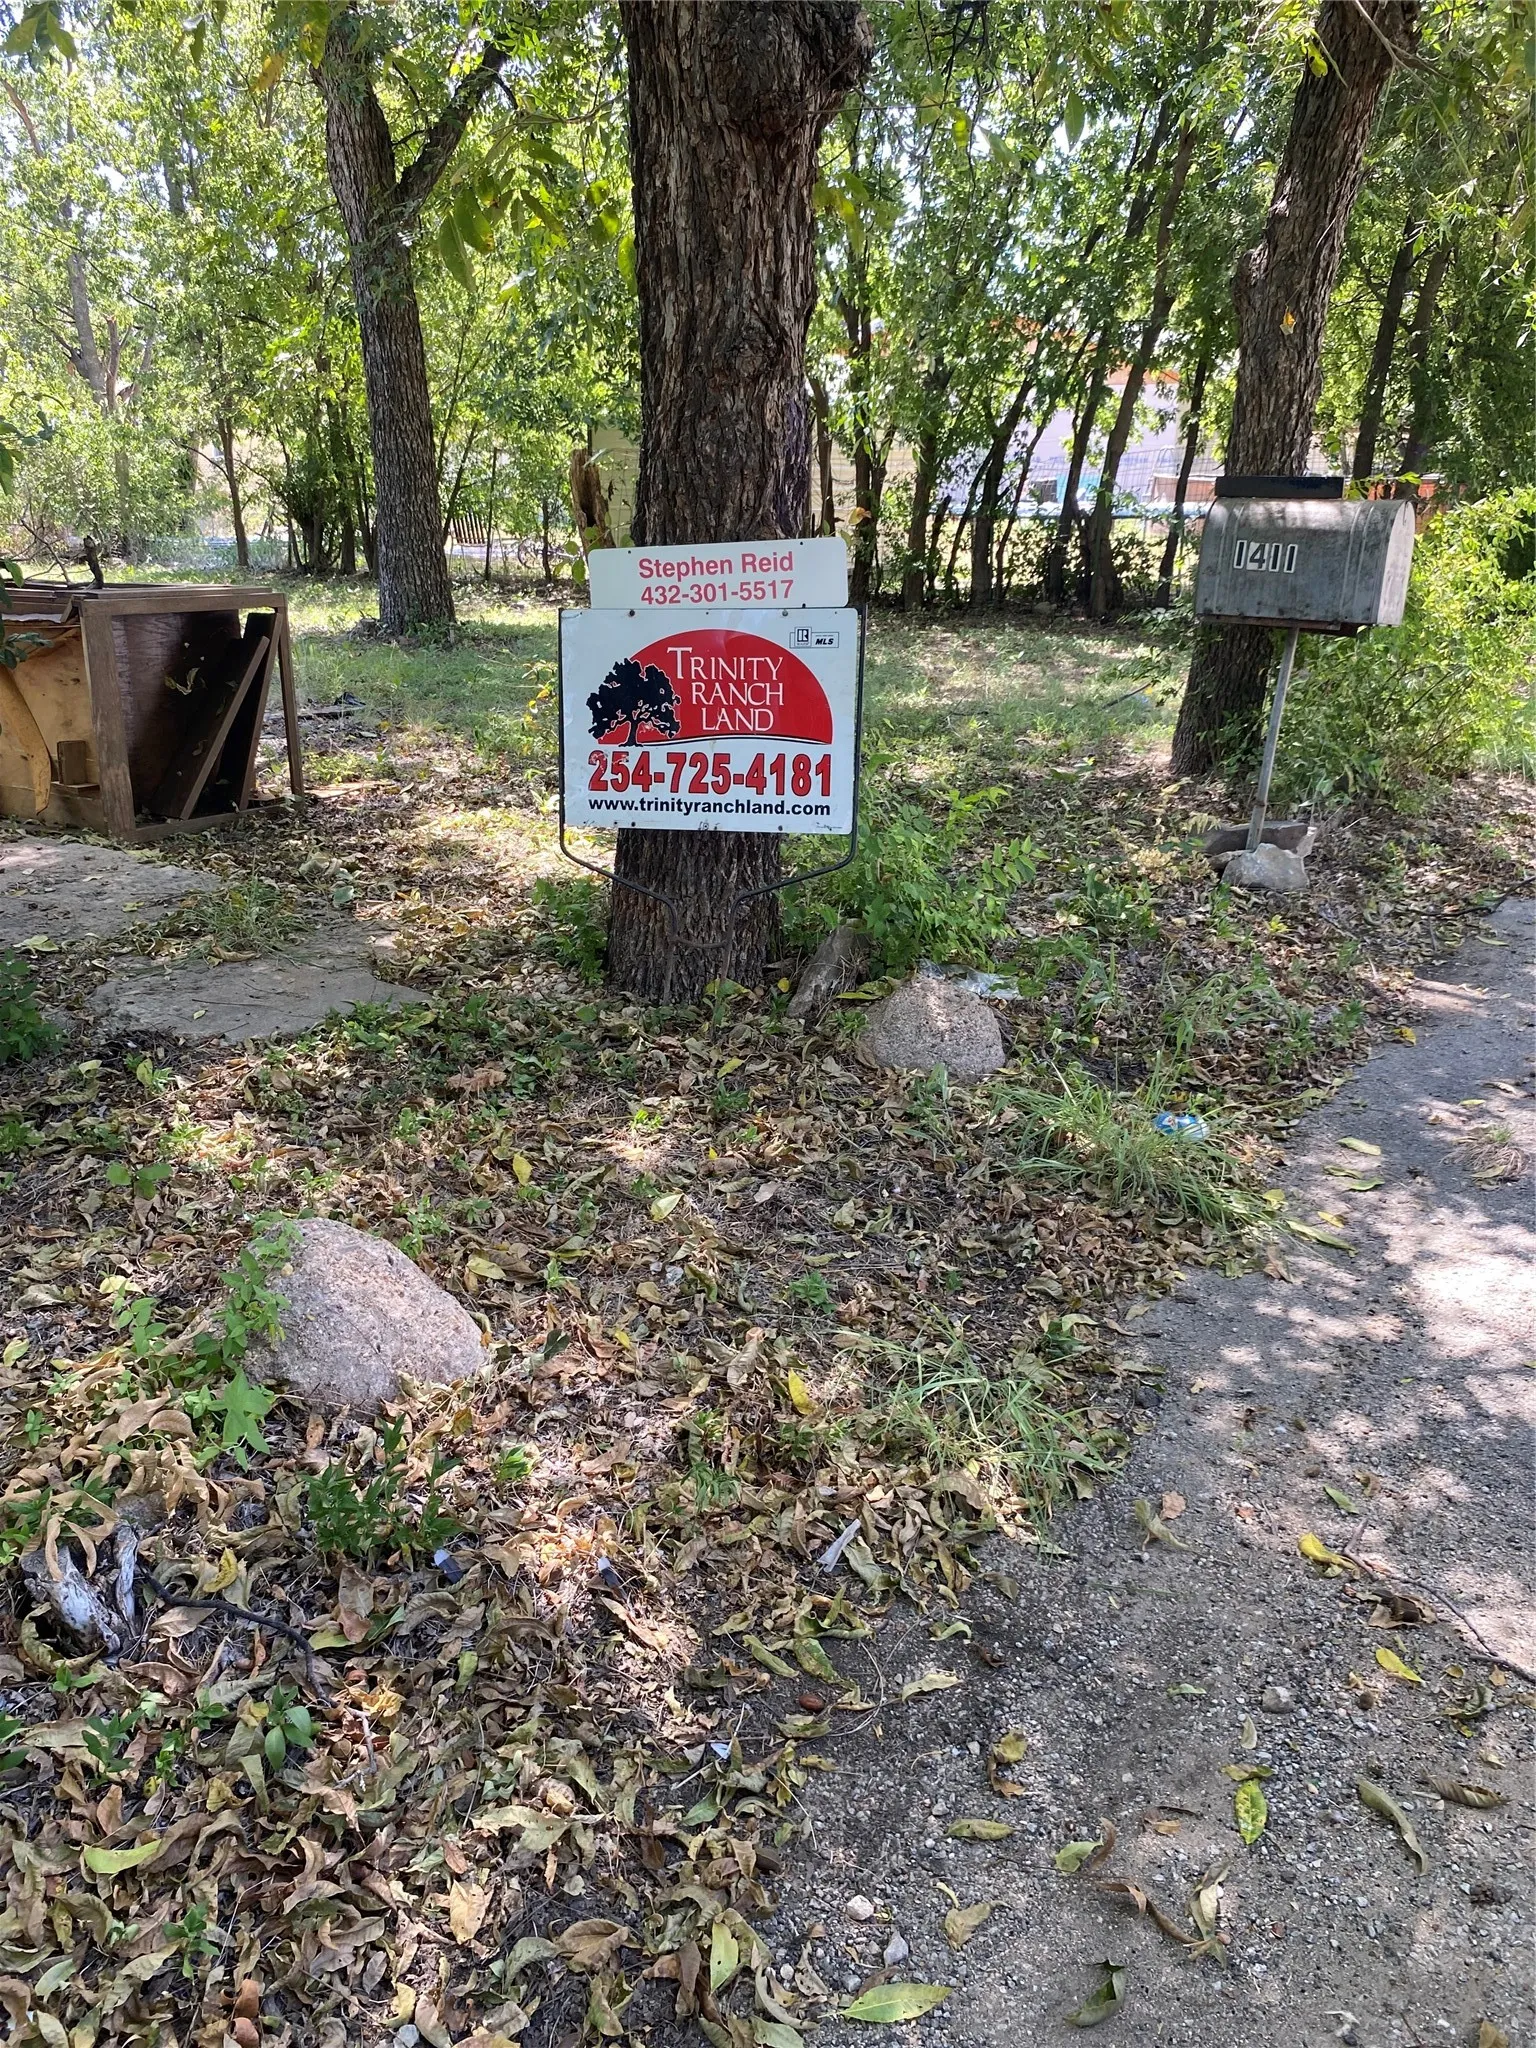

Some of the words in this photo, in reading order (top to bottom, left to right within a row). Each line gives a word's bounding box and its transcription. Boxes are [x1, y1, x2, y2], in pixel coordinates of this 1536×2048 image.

[638, 556, 733, 582] Stephen
[741, 551, 794, 574] Reid
[1234, 541, 1297, 573] 1411
[640, 579, 794, 605] 432-301-5517
[667, 647, 783, 680] TRINITY
[691, 682, 784, 706] RANCH
[702, 707, 774, 731] LAND
[588, 750, 832, 797] 254-725-4181
[588, 797, 831, 816] www.trinityranchland.com
